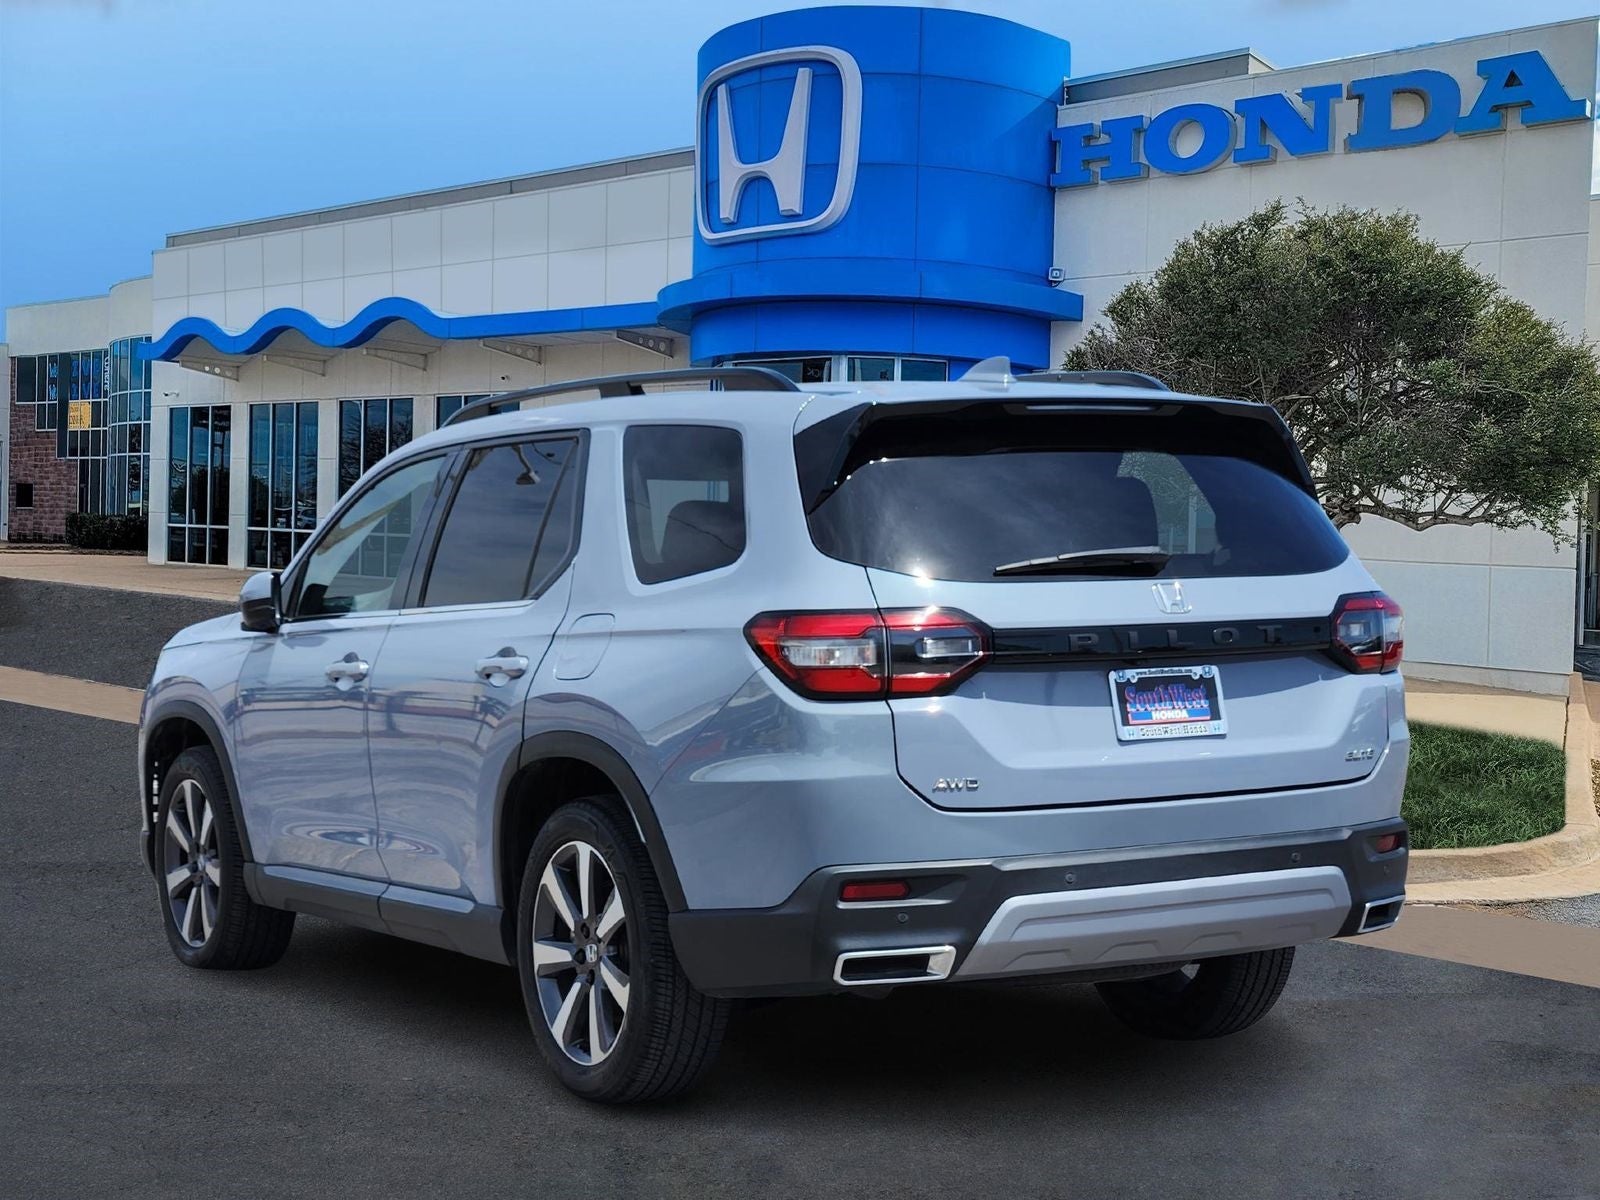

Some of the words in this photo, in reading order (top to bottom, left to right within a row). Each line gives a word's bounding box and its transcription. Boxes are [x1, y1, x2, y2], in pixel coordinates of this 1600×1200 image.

[1050, 50, 1591, 188] HONDA
[1068, 624, 1283, 653] PILOT
[1125, 683, 1209, 712] SouthWest
[1151, 710, 1189, 720] HONDA
[932, 777, 980, 793] AWD
